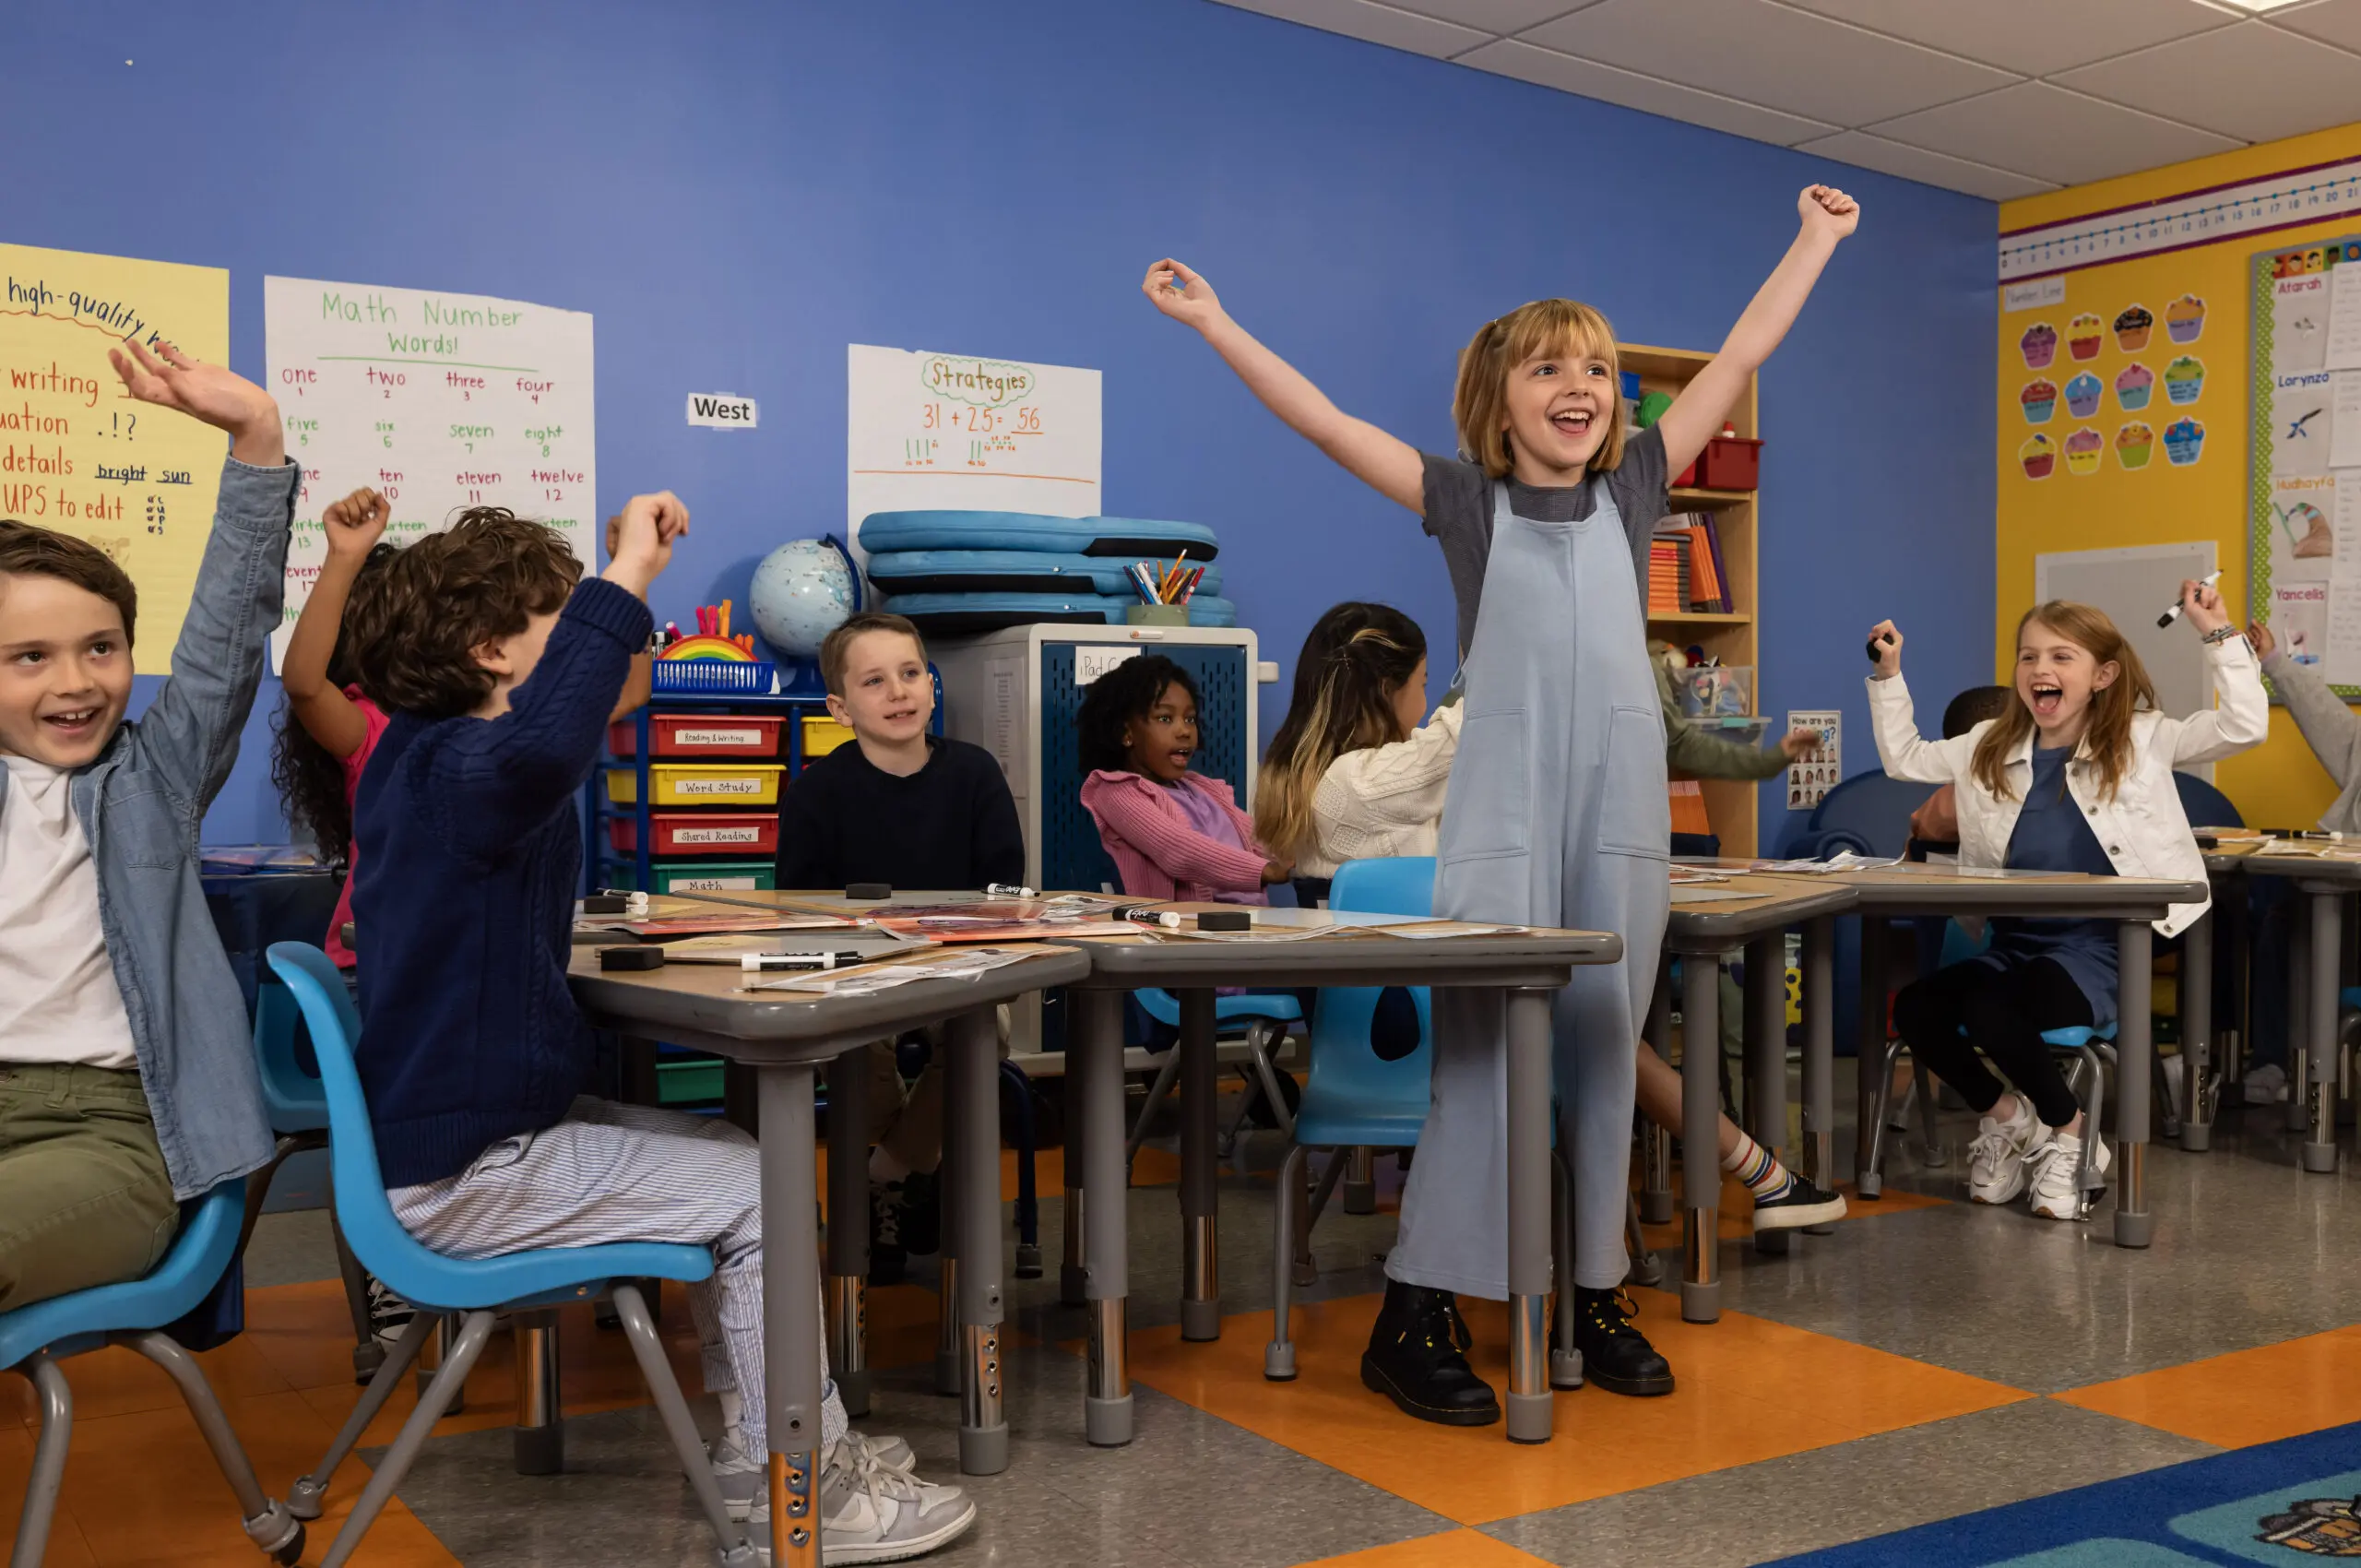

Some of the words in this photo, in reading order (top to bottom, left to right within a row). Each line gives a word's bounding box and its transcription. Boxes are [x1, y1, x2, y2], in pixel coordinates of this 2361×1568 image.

[2278, 279, 2322, 294] Atarah
[8, 277, 144, 342] high-quality
[323, 291, 397, 324] Math
[423, 298, 523, 327] Number
[387, 331, 458, 356] Words!
[11, 362, 99, 408] writing
[282, 368, 317, 384] one
[366, 366, 406, 386] two
[445, 371, 486, 389] three
[516, 377, 554, 392] four
[932, 362, 1026, 402] Strategies
[384, 389, 391, 398] 2
[464, 391, 471, 401] 3
[531, 394, 539, 405] 4
[694, 397, 750, 421] West
[923, 403, 939, 429] 31
[1017, 407, 1040, 430] 56
[287, 416, 319, 431] five
[375, 419, 395, 432] six
[449, 424, 494, 438] seven
[524, 425, 564, 445] eight
[300, 434, 308, 446] 5
[383, 435, 393, 448] 6
[465, 443, 473, 454] 7
[541, 445, 551, 458] 8
[2, 445, 74, 476] details
[95, 464, 148, 485] bright
[161, 470, 191, 484] sun
[379, 468, 404, 482] ten
[457, 471, 502, 485] eleven
[531, 469, 585, 484] twelve
[4, 484, 47, 517] UPS
[55, 489, 77, 517] to
[85, 493, 125, 521] edit
[384, 486, 399, 500] 10
[469, 489, 481, 504] 11
[545, 489, 564, 502] 12
[2276, 588, 2325, 601] Yancelis
[1080, 656, 1103, 678] iPad
[1792, 717, 1807, 725] How
[1824, 718, 1836, 726] you
[685, 732, 710, 743] Reading
[718, 734, 744, 742] Writing
[686, 782, 713, 792] Word
[718, 782, 752, 793] Study
[682, 831, 710, 841] Shared
[716, 831, 752, 841] Reading
[689, 881, 723, 891] Math
